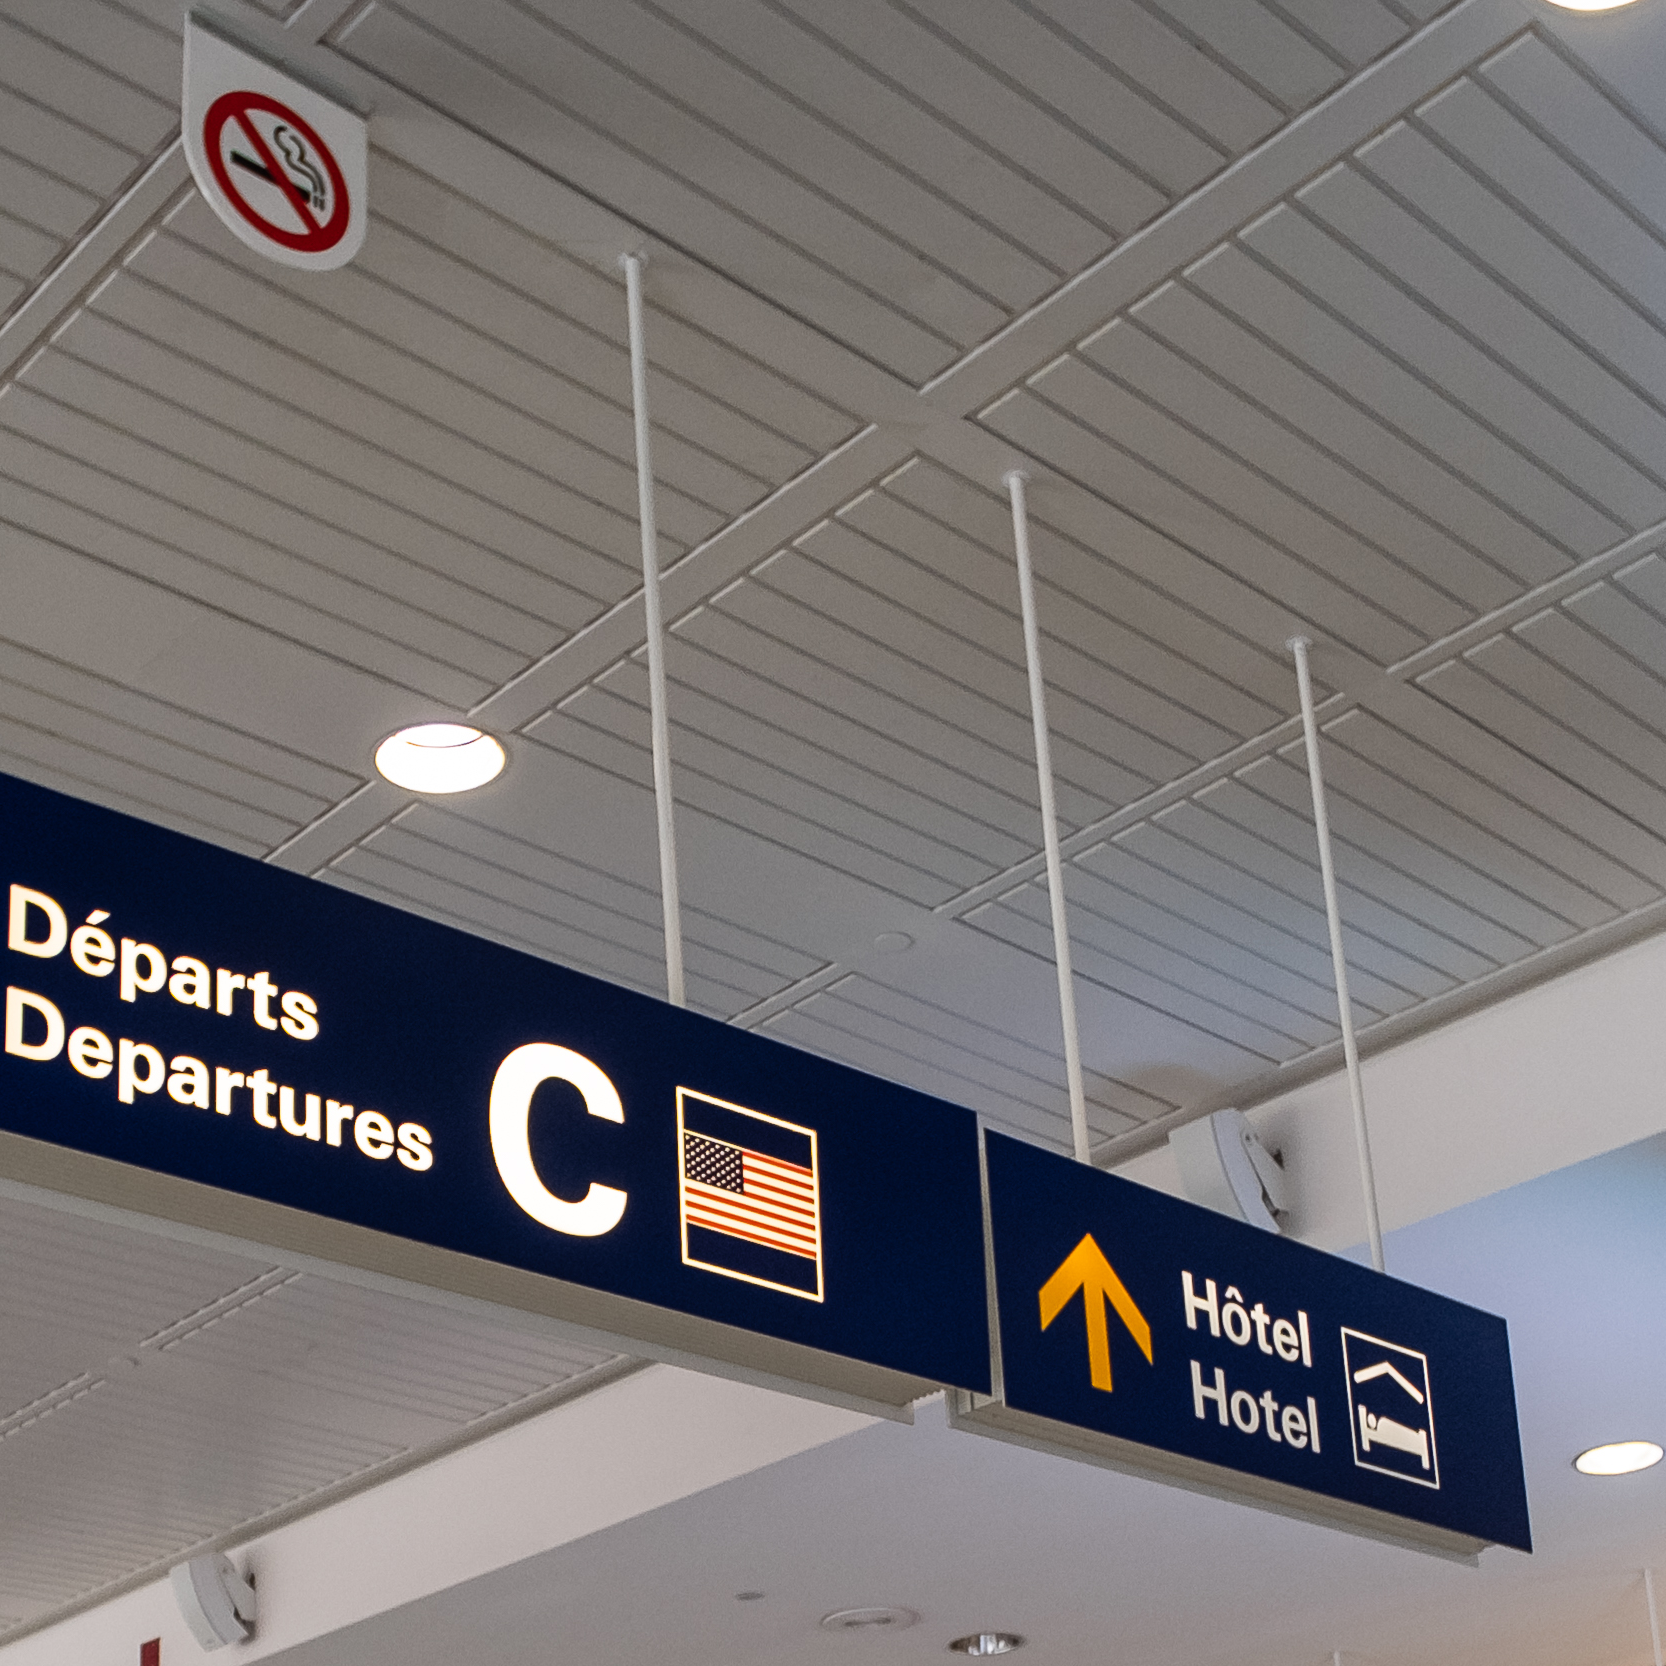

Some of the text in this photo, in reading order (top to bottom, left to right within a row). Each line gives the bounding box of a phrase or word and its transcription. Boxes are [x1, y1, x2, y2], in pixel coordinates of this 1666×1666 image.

[8, 884, 319, 1041] Départs
[5, 986, 433, 1171] Departures
[489, 1043, 628, 1237] C
[1181, 1270, 1312, 1368] Hôtel
[1190, 1359, 1321, 1454] Hotel
